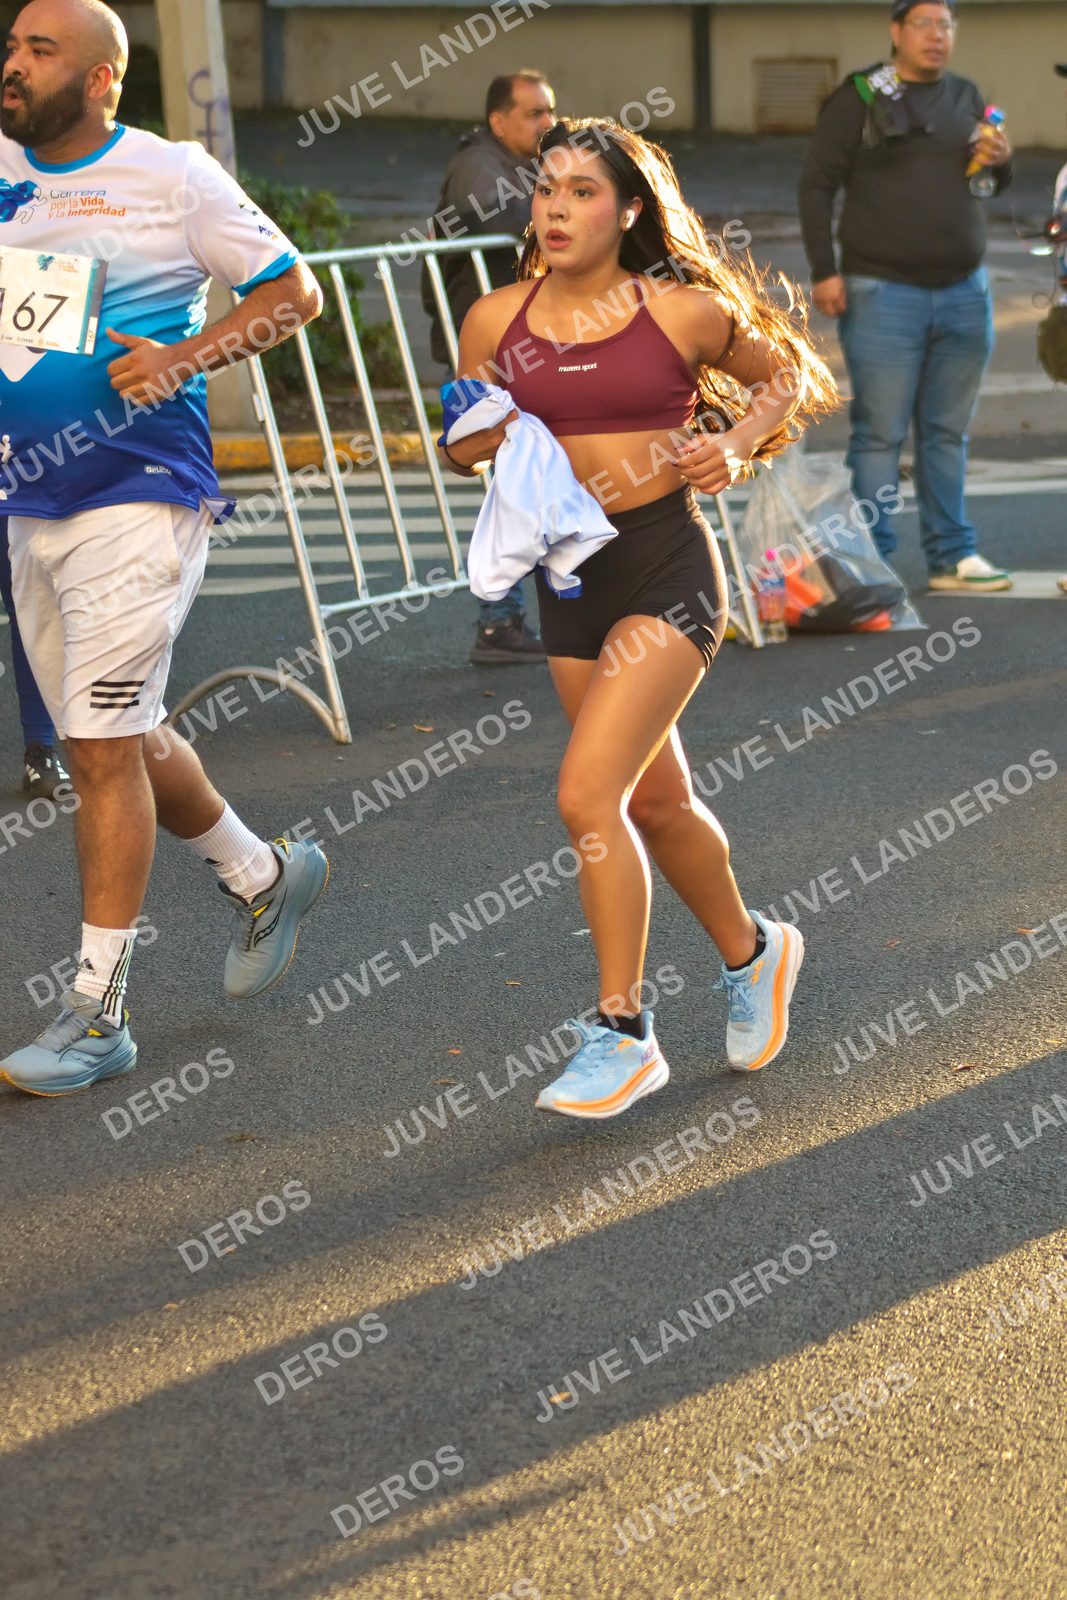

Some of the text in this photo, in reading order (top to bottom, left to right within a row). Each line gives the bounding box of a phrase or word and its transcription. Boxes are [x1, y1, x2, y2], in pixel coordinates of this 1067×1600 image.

[50, 189, 107, 199] Carrera
[50, 196, 105, 211] por la Vida
[48, 207, 126, 220] y la Integridad
